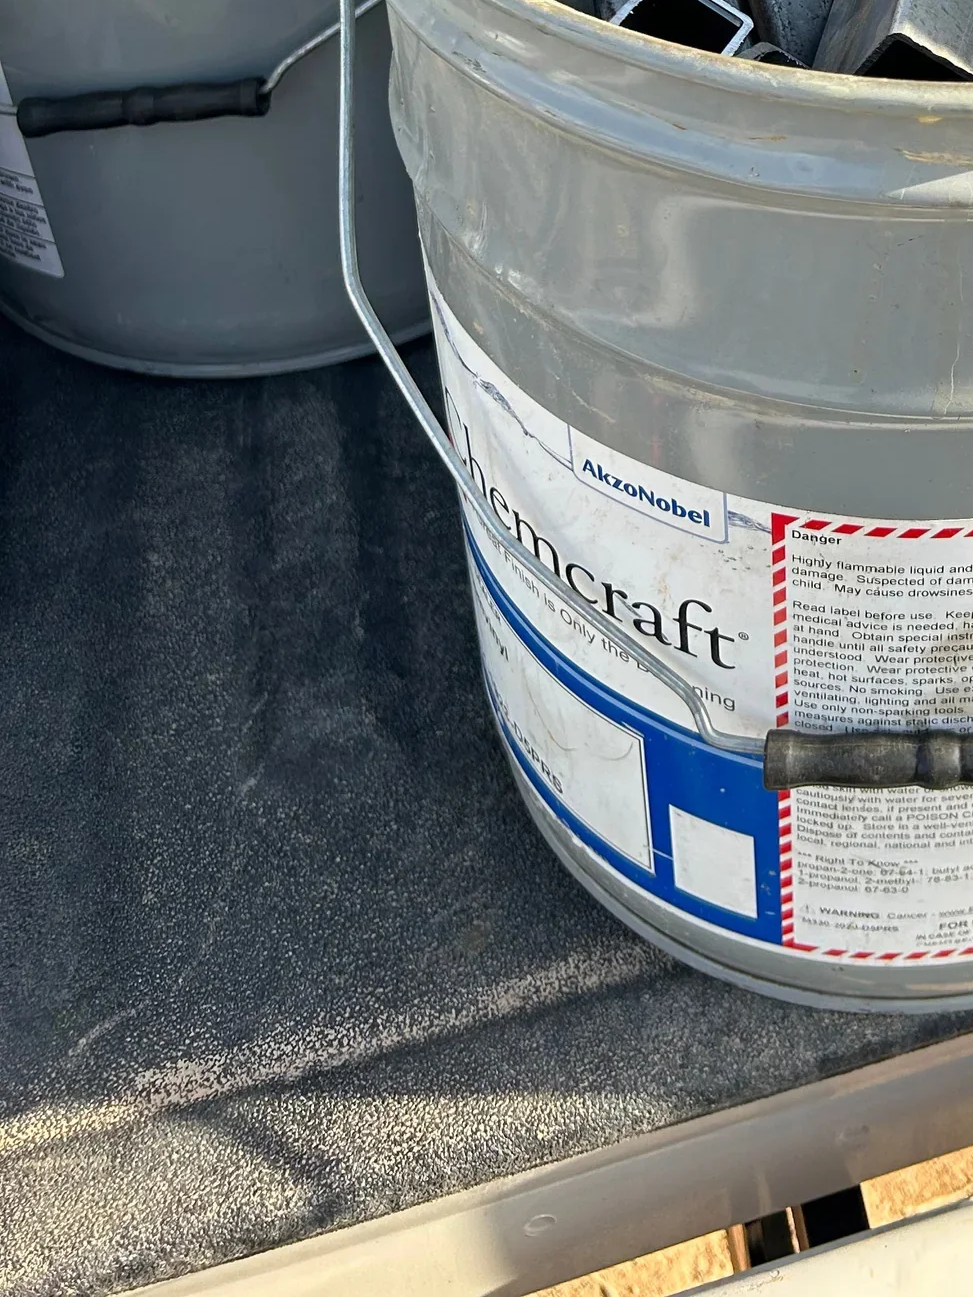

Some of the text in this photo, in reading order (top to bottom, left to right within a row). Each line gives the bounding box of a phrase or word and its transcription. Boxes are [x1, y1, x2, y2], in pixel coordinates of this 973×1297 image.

[582, 458, 711, 528] AkzoNobel
[791, 528, 842, 545] Danger
[791, 554, 832, 571] Highly
[836, 560, 905, 574] flammable
[909, 564, 944, 576] liquid
[949, 563, 973, 574] and
[834, 582, 861, 596] May
[865, 587, 903, 597] cause
[856, 573, 924, 587] Suspected
[929, 576, 942, 586] of
[504, 553, 540, 598] Finish
[543, 595, 556, 613] is
[560, 608, 596, 644] Only
[602, 638, 630, 663] the
[792, 599, 825, 614] Read
[830, 605, 860, 617] label
[864, 608, 905, 620] before
[792, 612, 842, 627] medical
[846, 618, 888, 630] advice
[892, 621, 902, 631] is
[906, 620, 958, 632] needed,
[792, 623, 803, 633] at
[852, 629, 893, 642] Obtain
[898, 632, 942, 644] special
[793, 632, 834, 648] handle
[839, 640, 865, 651] until
[869, 642, 883, 652] all
[888, 643, 926, 655] safety
[874, 653, 910, 664] Wear
[793, 665, 823, 681] heat,
[828, 670, 847, 682] hot
[851, 674, 907, 687] surfaces,
[866, 663, 901, 674] Wear
[905, 664, 967, 676] protective
[793, 688, 860, 705] ventilating,
[865, 694, 909, 707] lighting
[913, 696, 936, 706] and
[940, 695, 955, 705] all
[849, 683, 867, 694] No
[794, 708, 853, 724] measures
[857, 715, 901, 727] against
[905, 716, 938, 726] static
[821, 702, 847, 715] only
[851, 705, 930, 718] non-sparking
[959, 725, 971, 734] or
[939, 920, 968, 930] FOR
